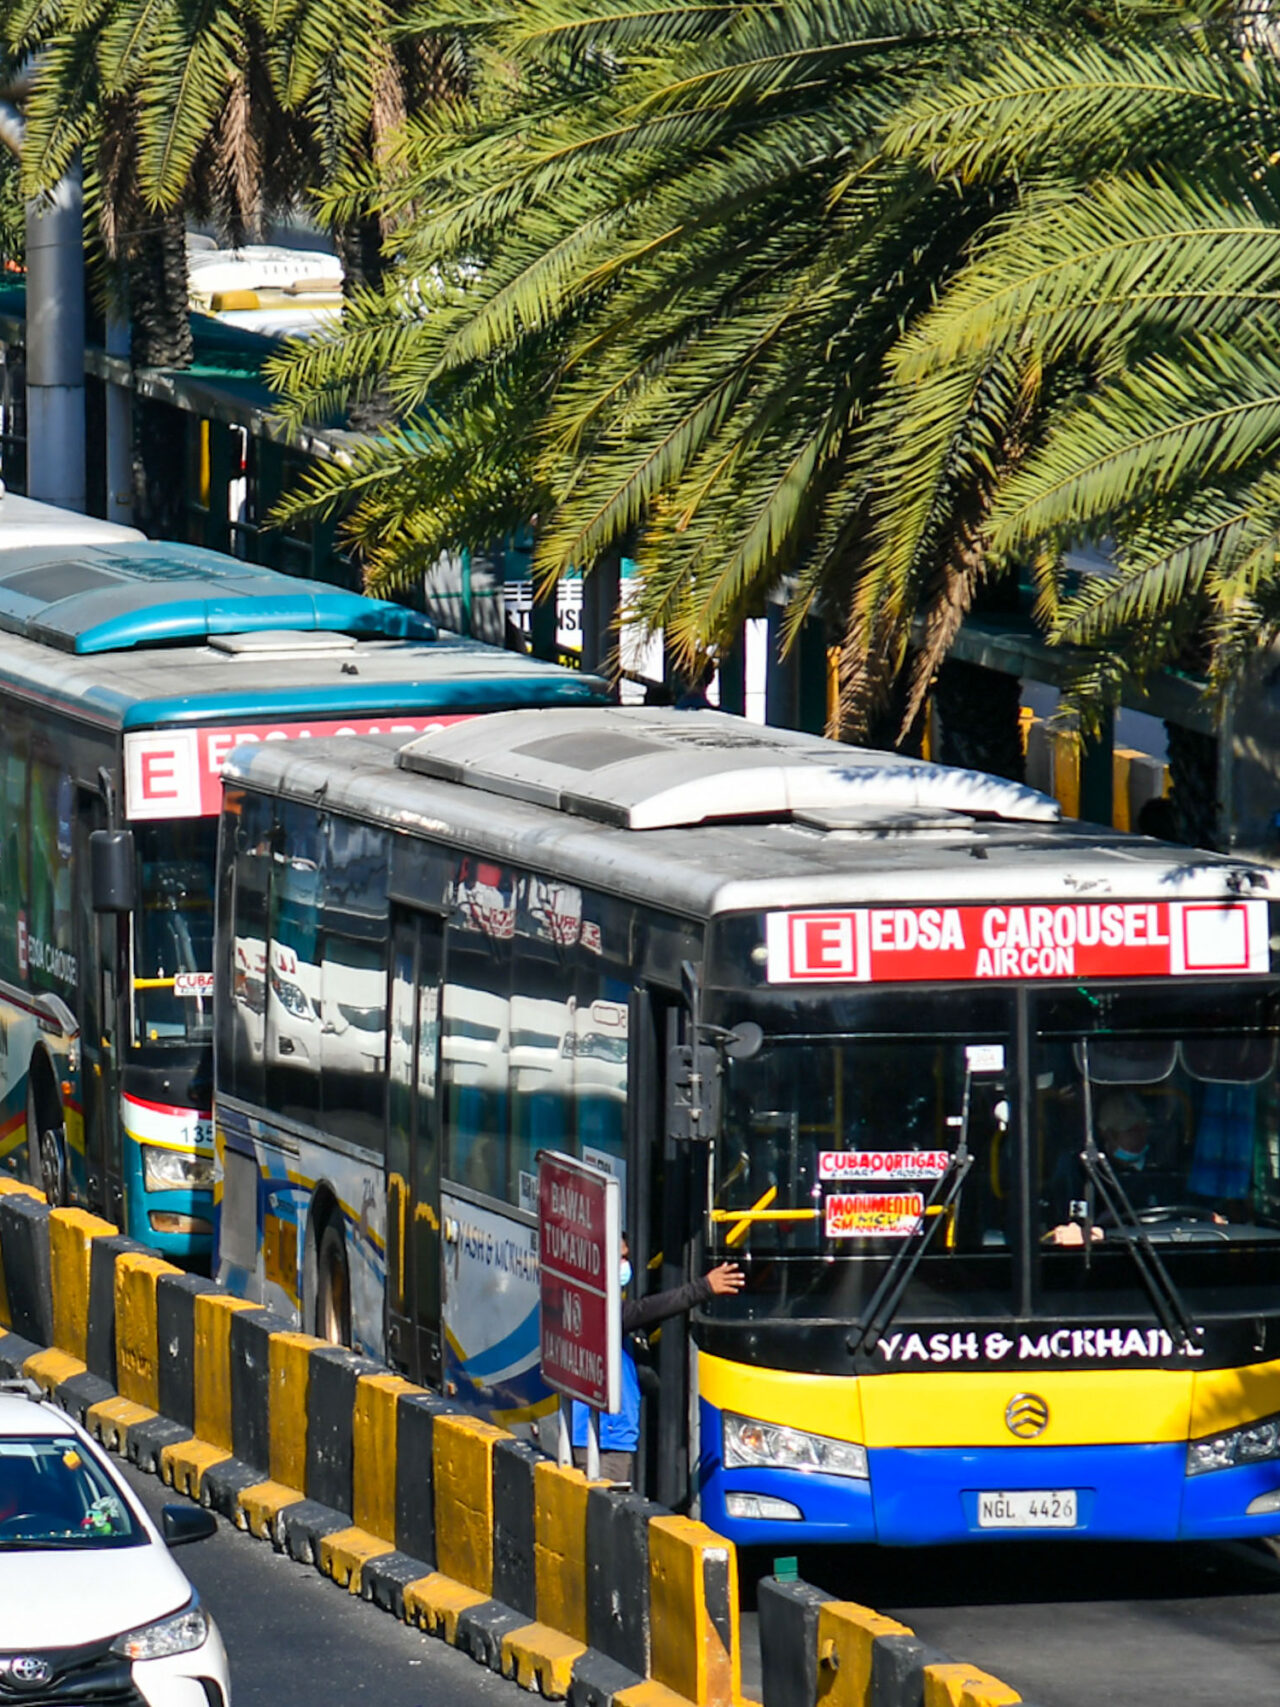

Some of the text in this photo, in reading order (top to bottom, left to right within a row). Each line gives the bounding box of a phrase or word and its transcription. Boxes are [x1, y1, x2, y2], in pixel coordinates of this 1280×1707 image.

[141, 752, 178, 799] E
[806, 903, 1169, 969] E EDSA CAROUSEL
[176, 974, 215, 988] CUBA
[975, 946, 1074, 977] AIRCON
[551, 1181, 593, 1230] BAWAL
[828, 1194, 922, 1219] MONUMENTO
[495, 1239, 540, 1285] MCKHAIN
[544, 1221, 601, 1276] TUMAWID
[562, 1289, 583, 1337] NO
[544, 1327, 604, 1386] JAYWALKING
[877, 1332, 979, 1362] YASH
[984, 1332, 1014, 1359] &
[983, 1500, 1073, 1518] NGL 4426
